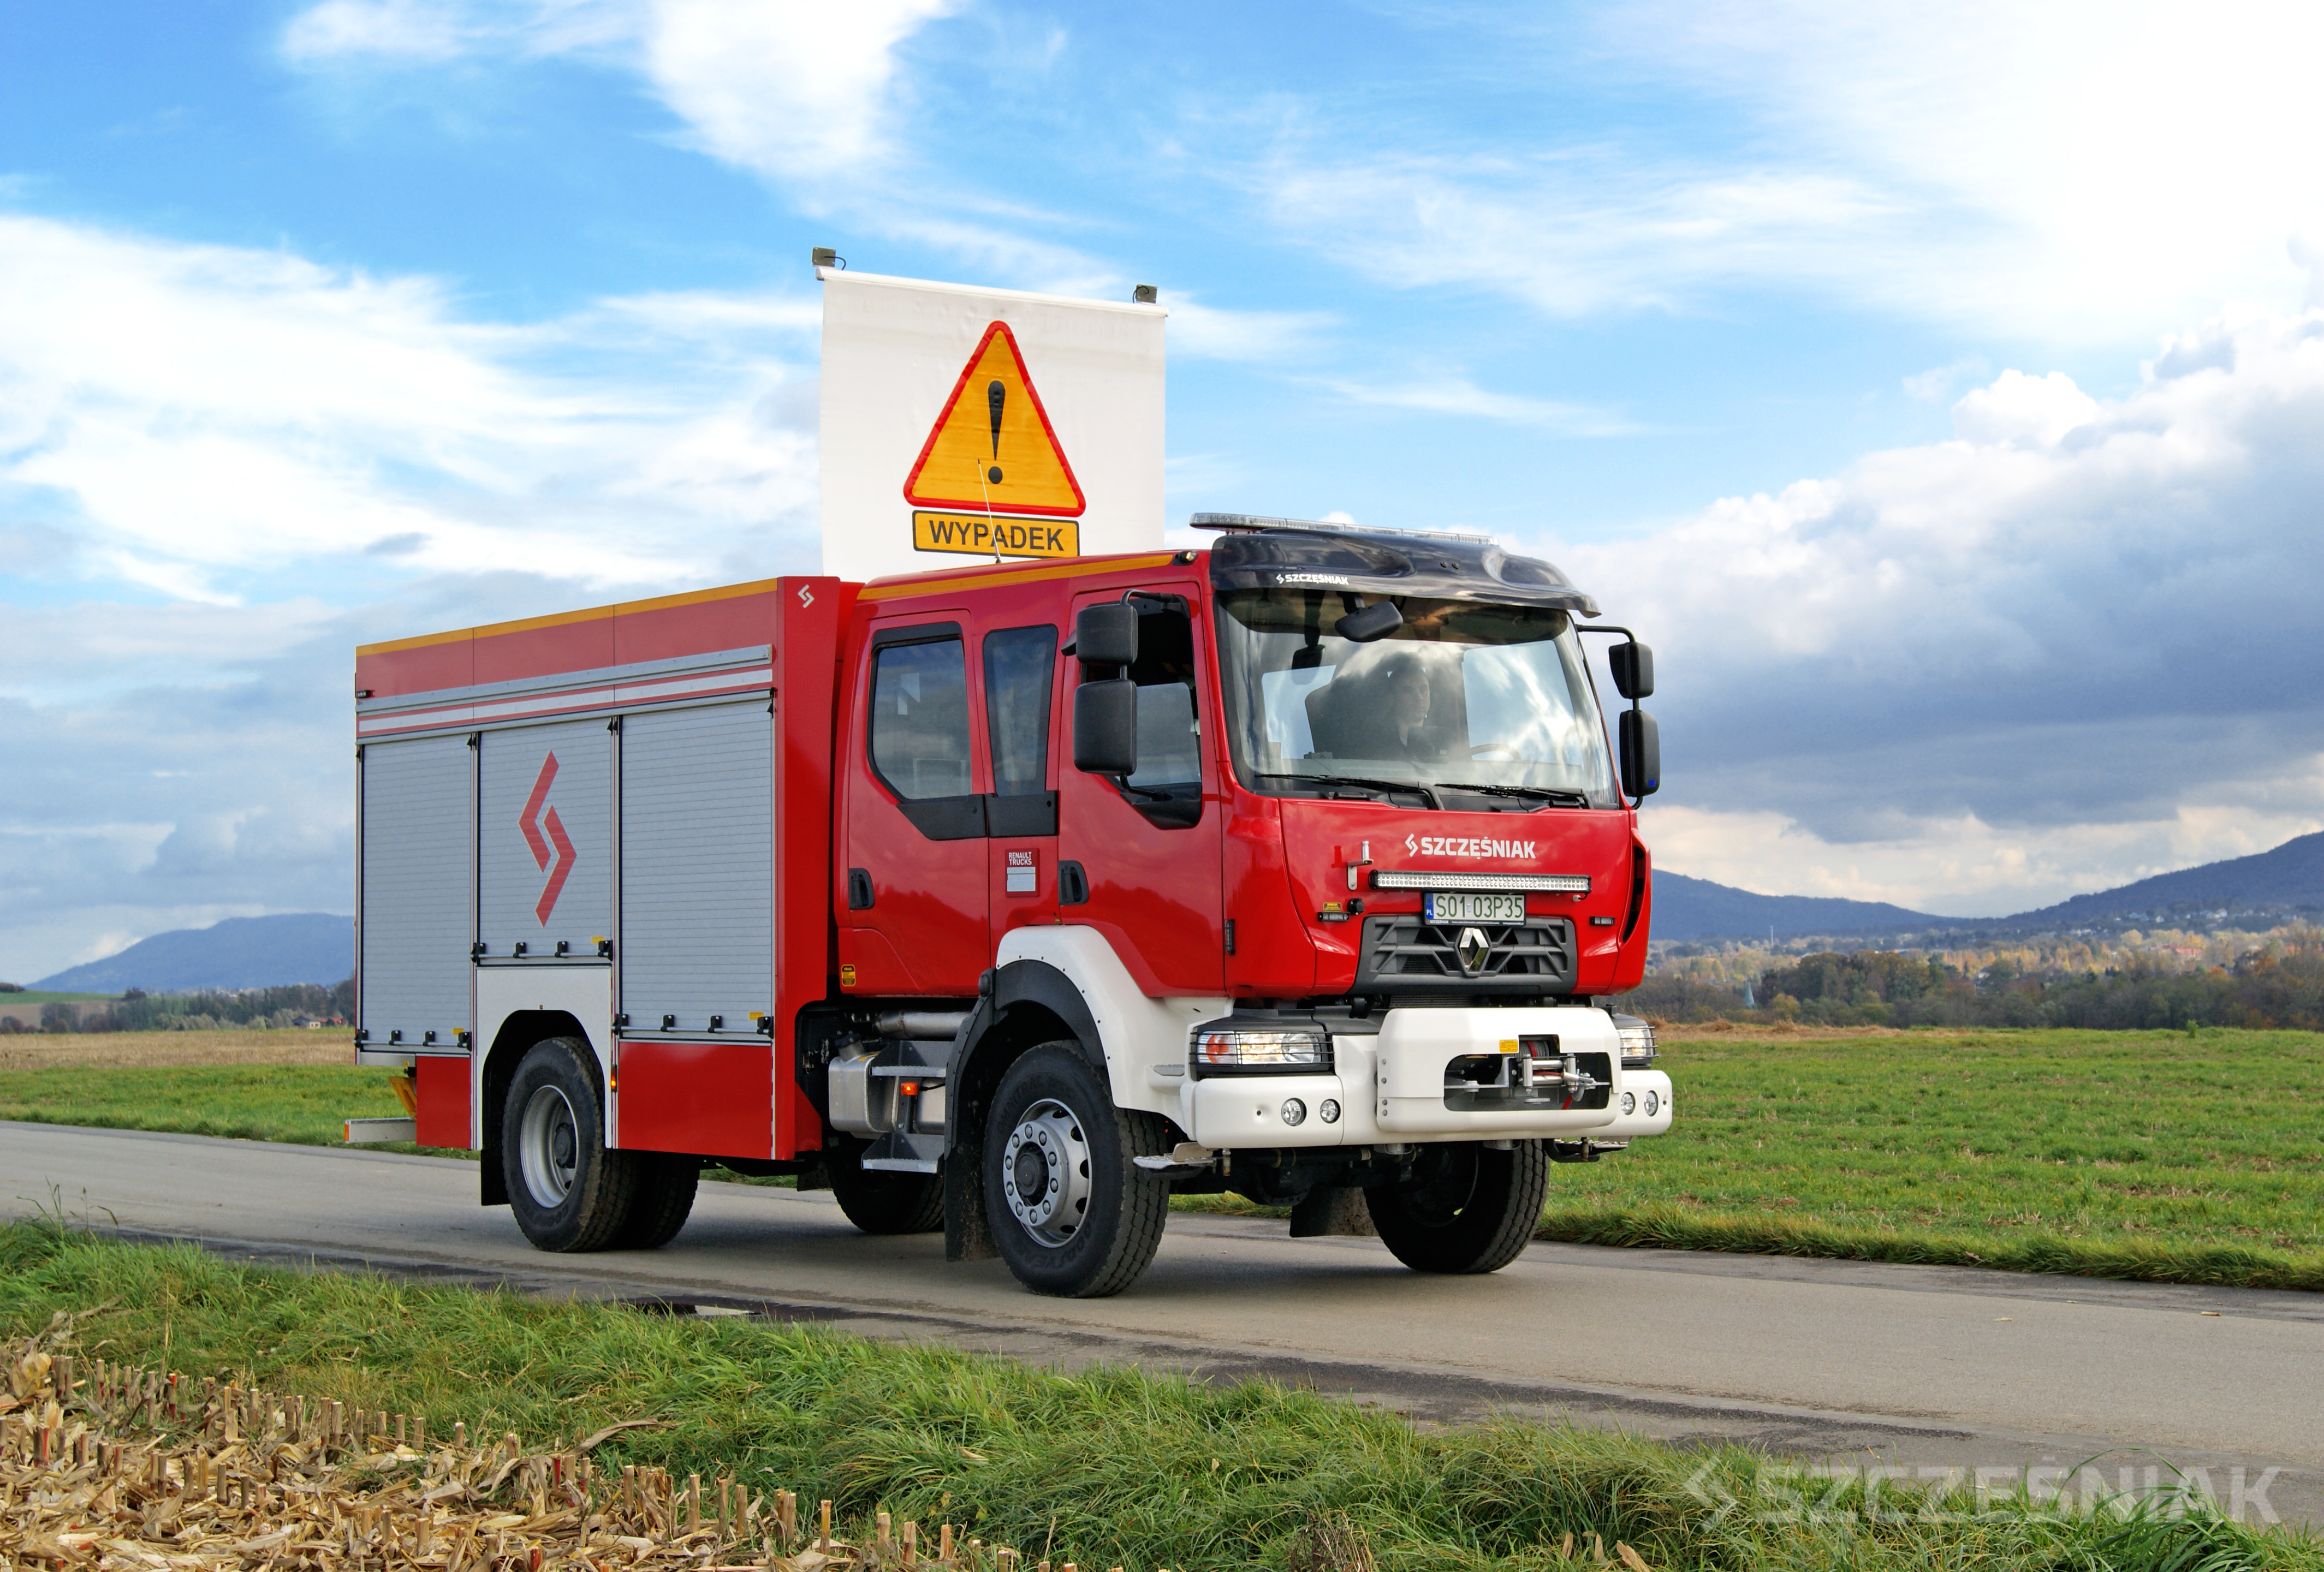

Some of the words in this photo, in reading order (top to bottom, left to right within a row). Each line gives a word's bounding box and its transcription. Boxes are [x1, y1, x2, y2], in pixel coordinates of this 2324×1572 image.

[929, 520, 1065, 551] WYPADEK
[1285, 574, 1350, 585] SZCZĘŚNIAK
[1420, 836, 1536, 860] SZCZĘŚNIAK
